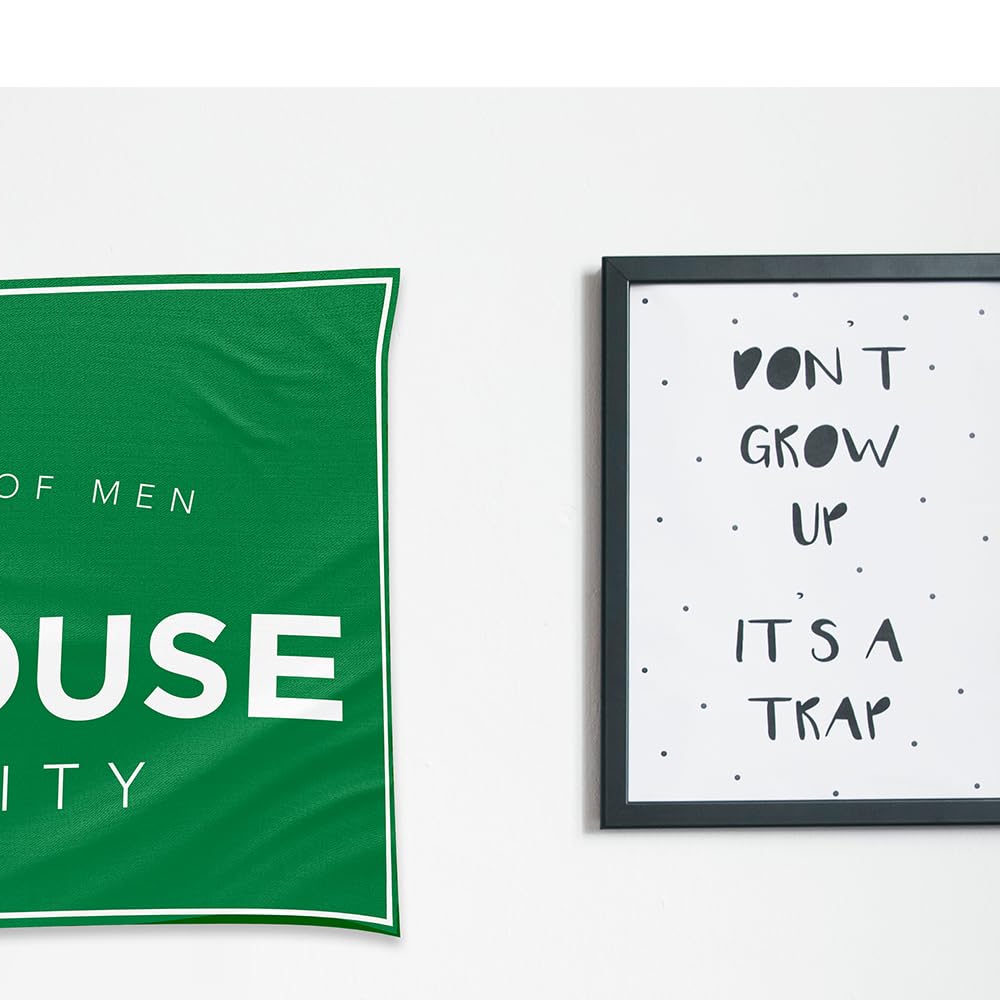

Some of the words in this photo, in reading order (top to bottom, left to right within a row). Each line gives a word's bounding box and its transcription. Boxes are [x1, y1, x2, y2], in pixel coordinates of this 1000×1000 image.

[732, 320, 908, 391] DON'T
[740, 424, 900, 469] GROW
[92, 478, 197, 515] MEN
[792, 502, 848, 546] UP
[735, 592, 840, 663] IT'S
[865, 618, 903, 663] A
[747, 696, 891, 741] TRAP
